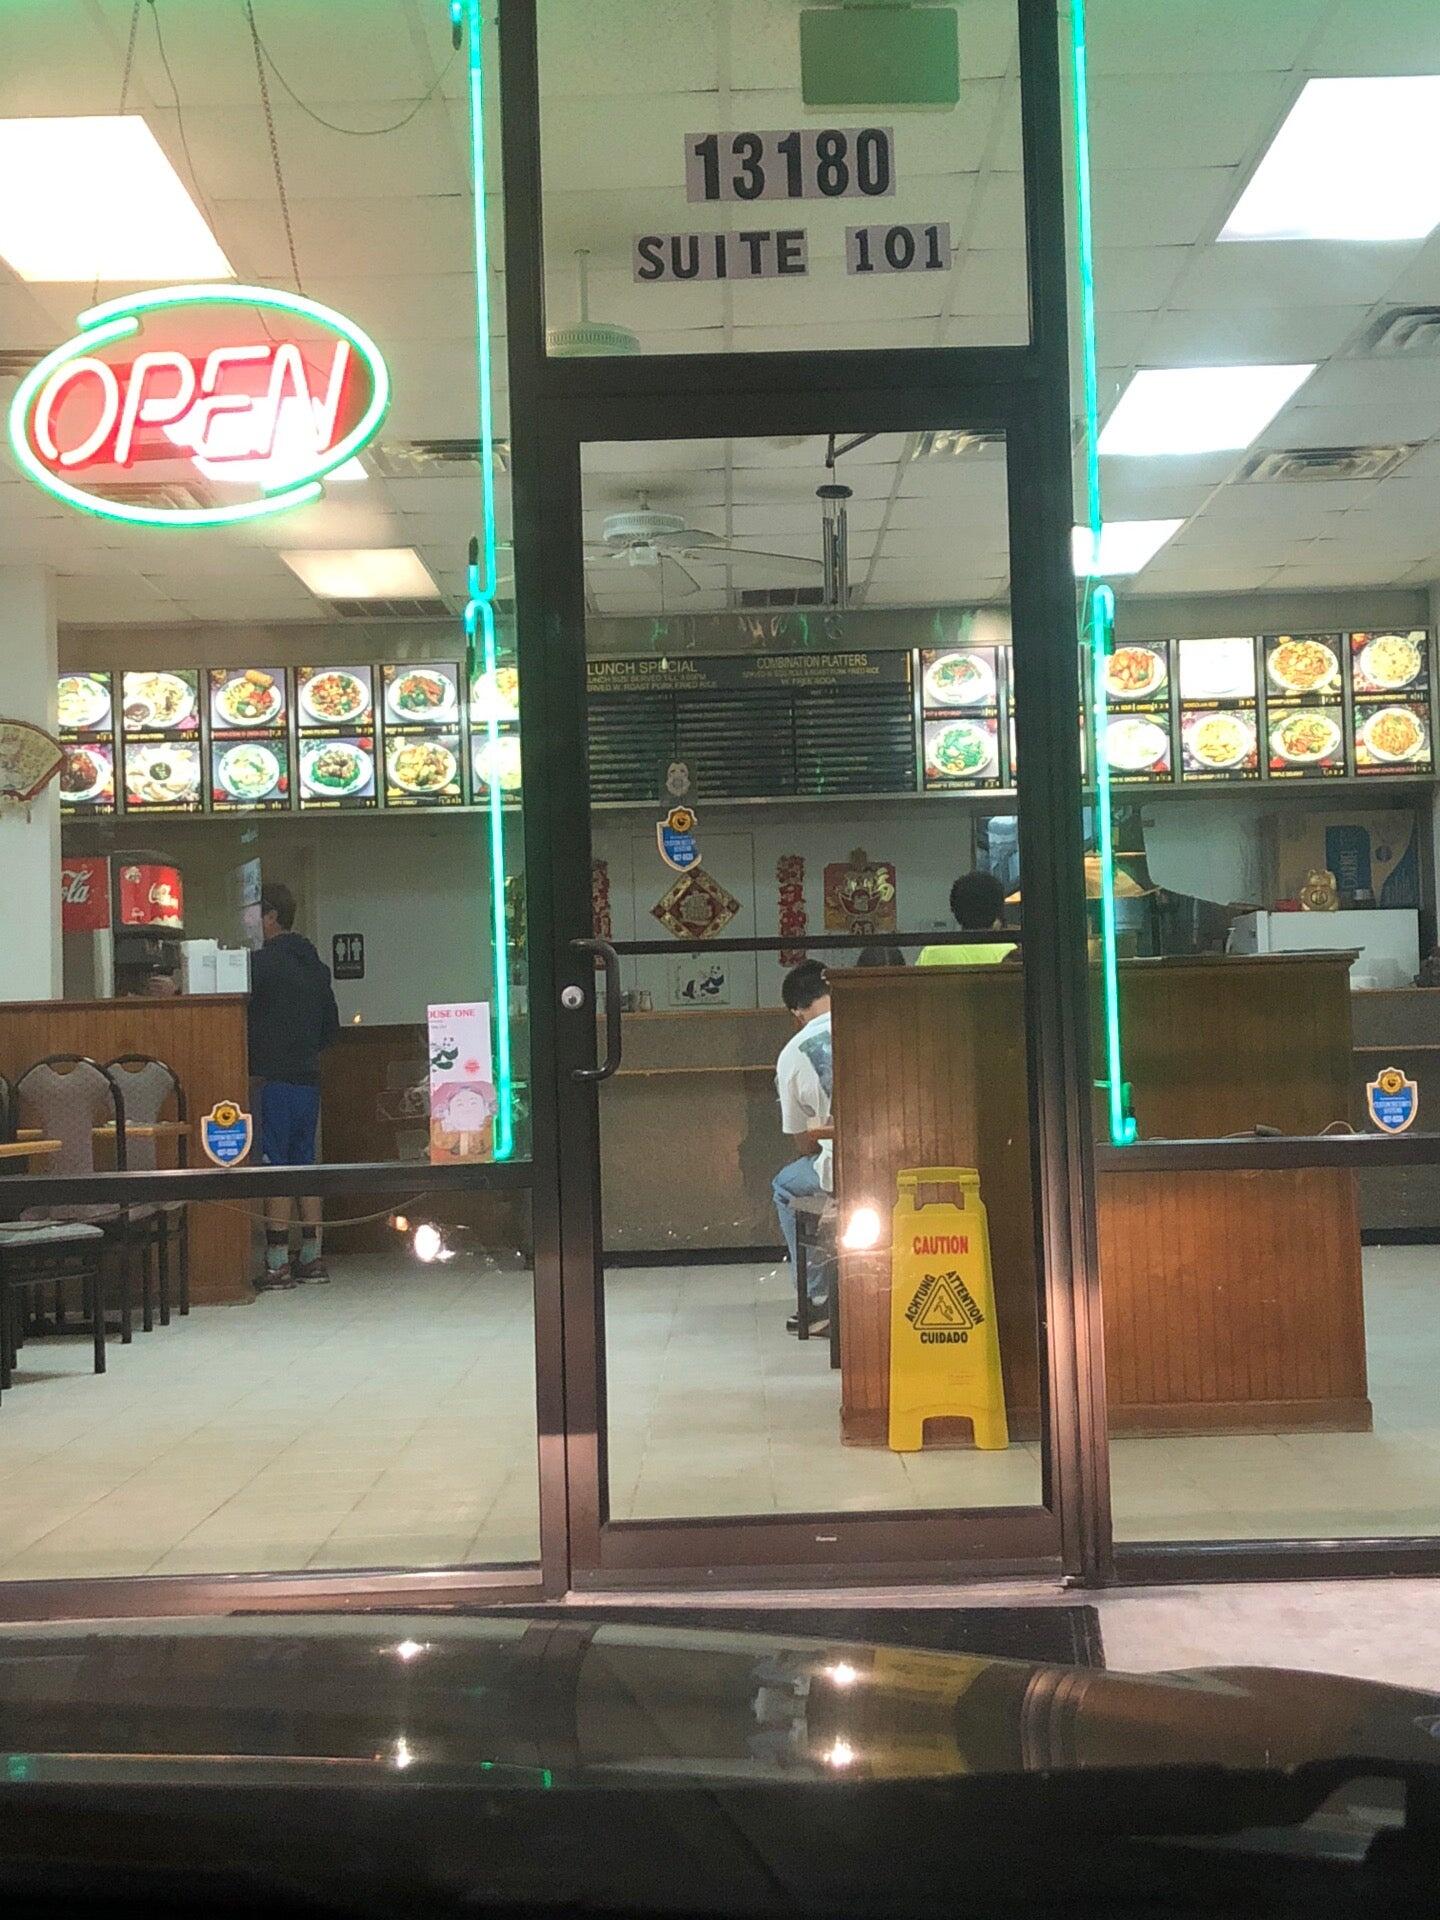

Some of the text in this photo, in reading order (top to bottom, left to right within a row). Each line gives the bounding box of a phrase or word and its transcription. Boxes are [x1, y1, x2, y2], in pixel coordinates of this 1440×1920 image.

[694, 128, 890, 200] 13180
[637, 225, 944, 280] SUITE 101
[34, 339, 351, 466] OPEN
[587, 661, 697, 675] LUNCH SPECIAL
[757, 654, 867, 669] COMBINATION PLATTERS
[455, 1008, 476, 1018] ONE
[912, 1235, 969, 1255] CAUTION
[904, 1273, 936, 1323] ACHTUNG
[945, 1270, 985, 1326] ATTENTION
[920, 1331, 969, 1344] CUIDADO
